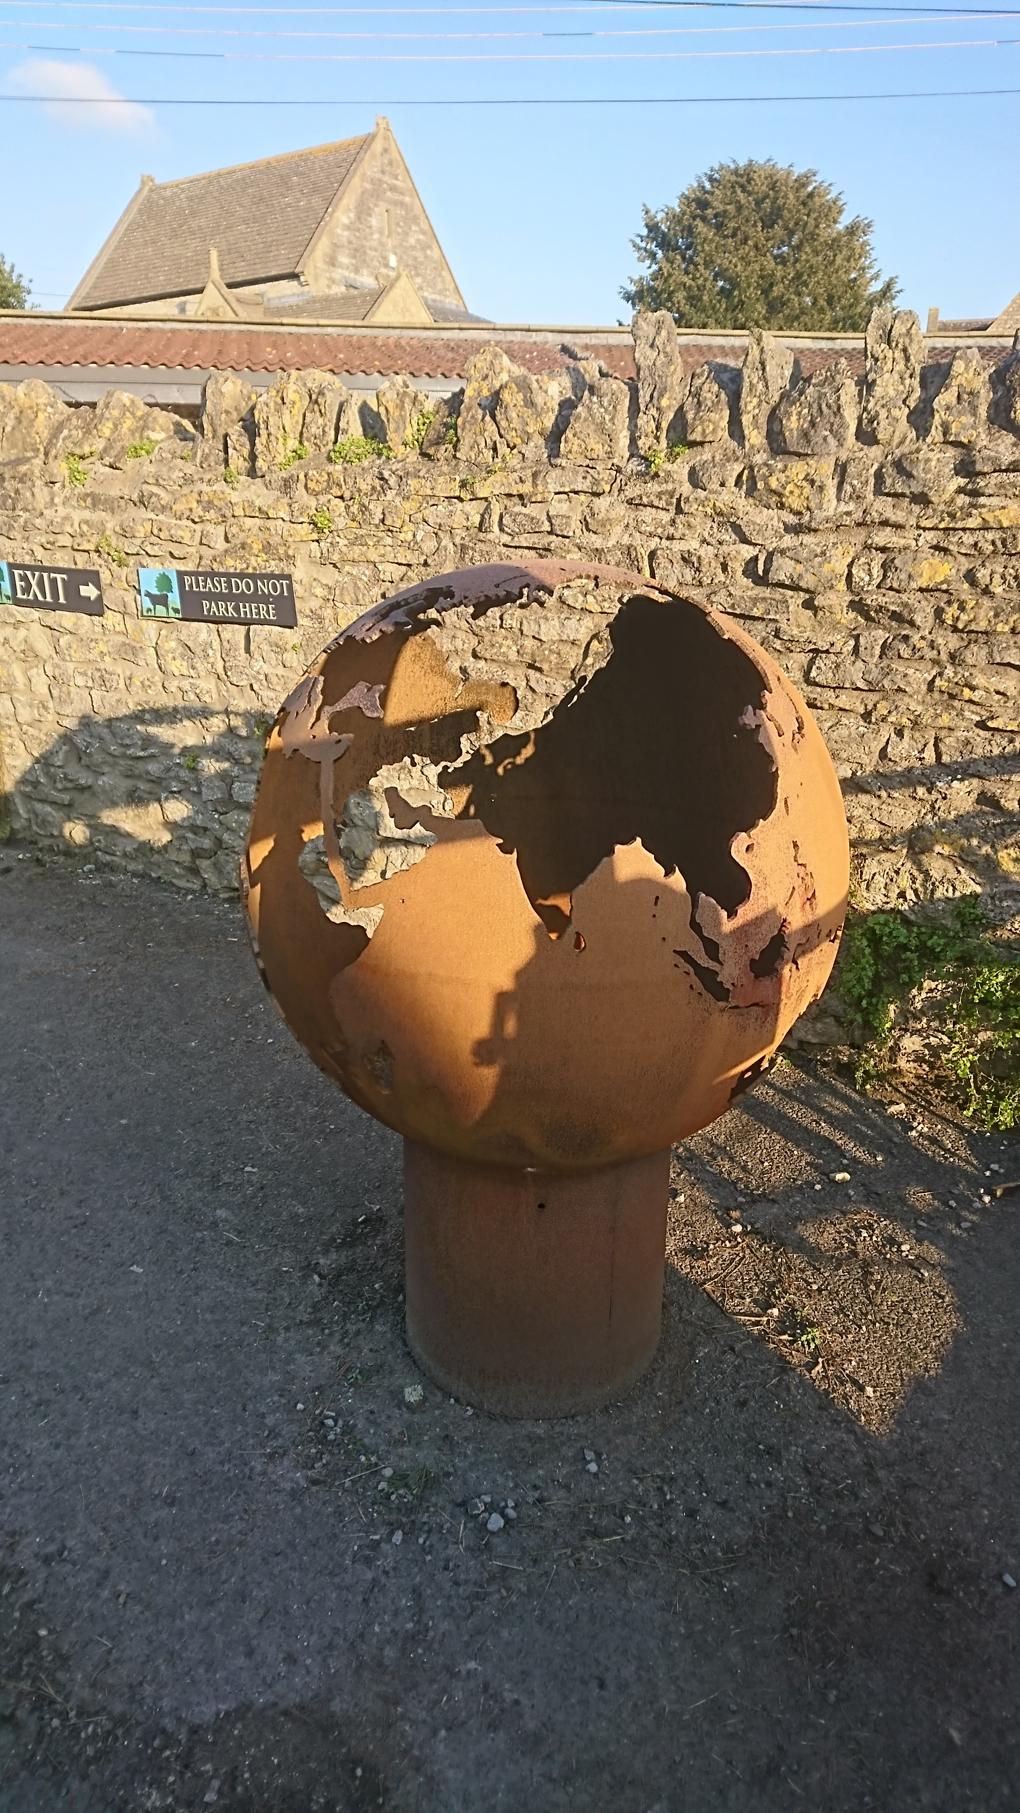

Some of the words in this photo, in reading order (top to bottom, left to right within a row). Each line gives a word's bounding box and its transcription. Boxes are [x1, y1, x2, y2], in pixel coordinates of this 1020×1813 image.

[12, 569, 67, 603] EXIT
[183, 575, 229, 593] PLEASE
[230, 577, 254, 594] DO
[257, 579, 289, 596] NOT
[202, 600, 238, 617] PARK
[239, 602, 277, 620] HERE
